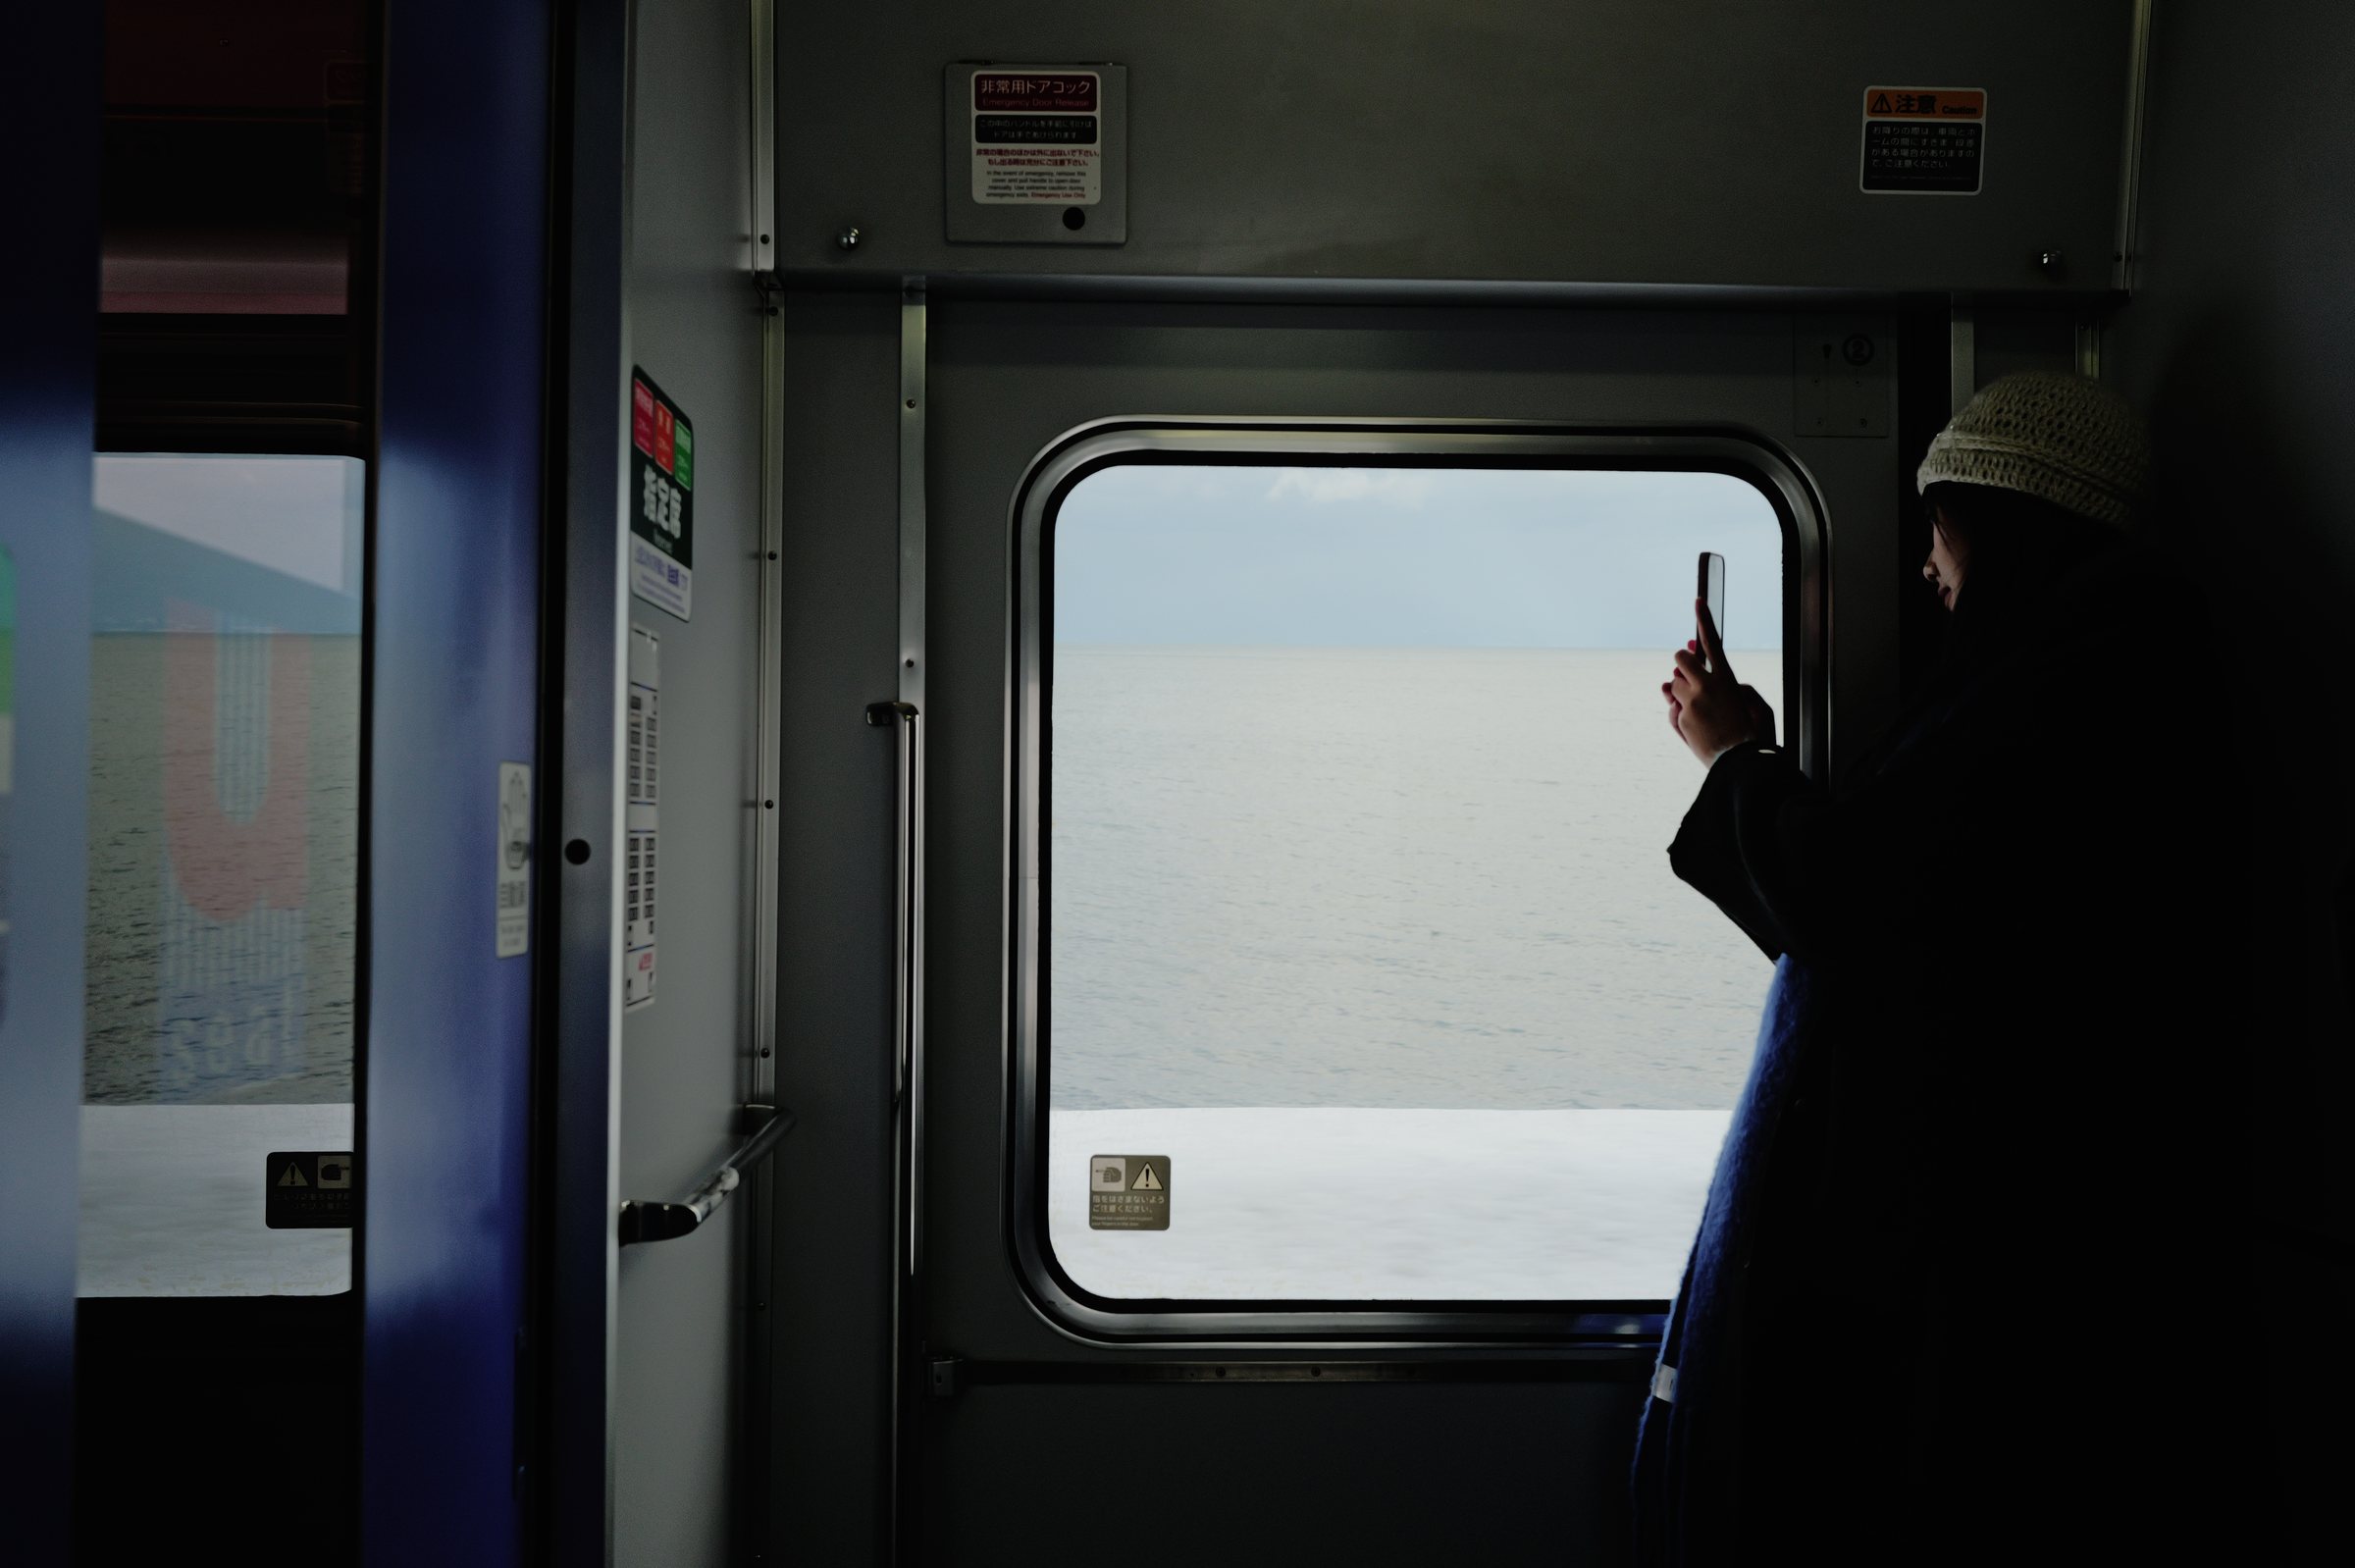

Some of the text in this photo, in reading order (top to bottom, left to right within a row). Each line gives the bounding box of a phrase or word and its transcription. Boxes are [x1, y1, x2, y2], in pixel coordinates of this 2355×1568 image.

[980, 78, 1091, 95] 非常用ドアコック
[982, 98, 1089, 108] Emergency Door Release
[1895, 94, 1937, 114] 注意
[1942, 105, 1977, 115] Caution
